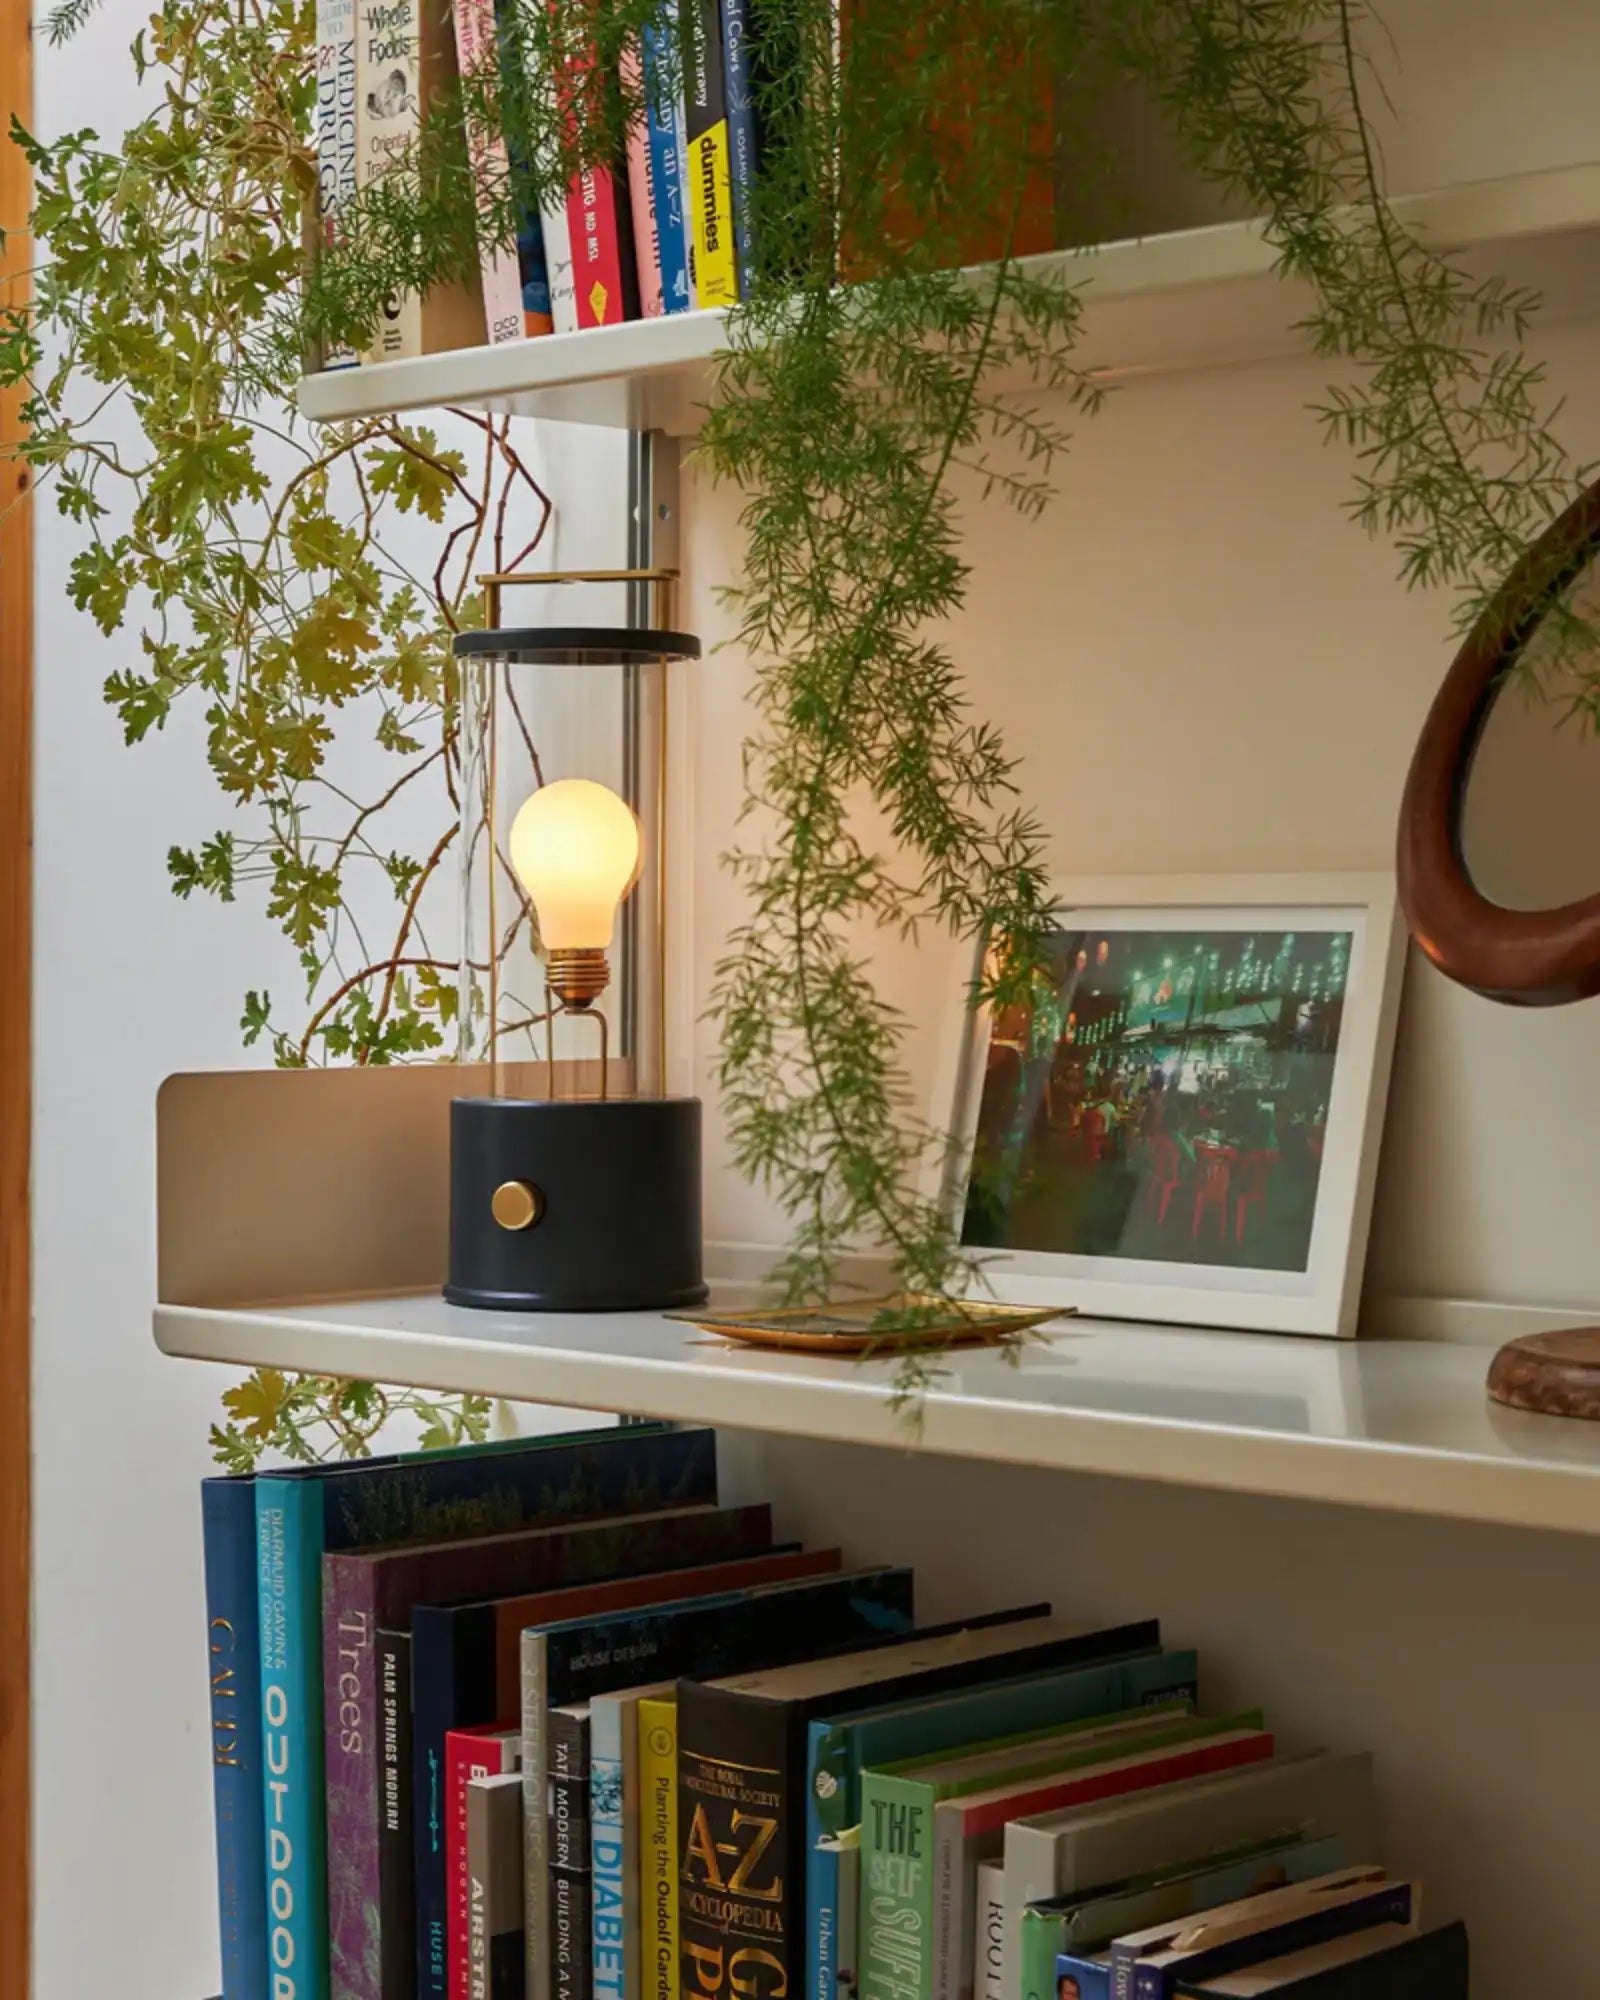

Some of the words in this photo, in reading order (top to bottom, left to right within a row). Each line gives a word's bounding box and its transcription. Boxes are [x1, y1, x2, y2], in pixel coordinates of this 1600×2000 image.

[727, 20, 743, 73] Cows
[319, 78, 337, 214] DRUGS
[663, 148, 677, 176] an
[699, 136, 721, 254] dummies
[259, 1509, 272, 1588] TERENCE
[271, 1508, 286, 1596] DIARMUID
[263, 1592, 275, 1669] CONRAN
[272, 1599, 287, 1654] GAVIN
[338, 1611, 370, 1754] Trees
[383, 1653, 397, 1693] PALM
[384, 1697, 398, 1762] SPRINGS
[556, 1742, 569, 1782] TATE
[385, 1767, 399, 1831] MODERN
[556, 1787, 570, 1868] MODERN
[652, 1777, 671, 1844] Planting
[870, 1799, 923, 1859] THE
[656, 1849, 670, 1876] the
[556, 1879, 571, 1964] BUILDING
[657, 1880, 672, 1942] Oudolf
[819, 1907, 833, 1961] Urban
[557, 1969, 571, 1982] A
[867, 1896, 922, 2000] SUFF
